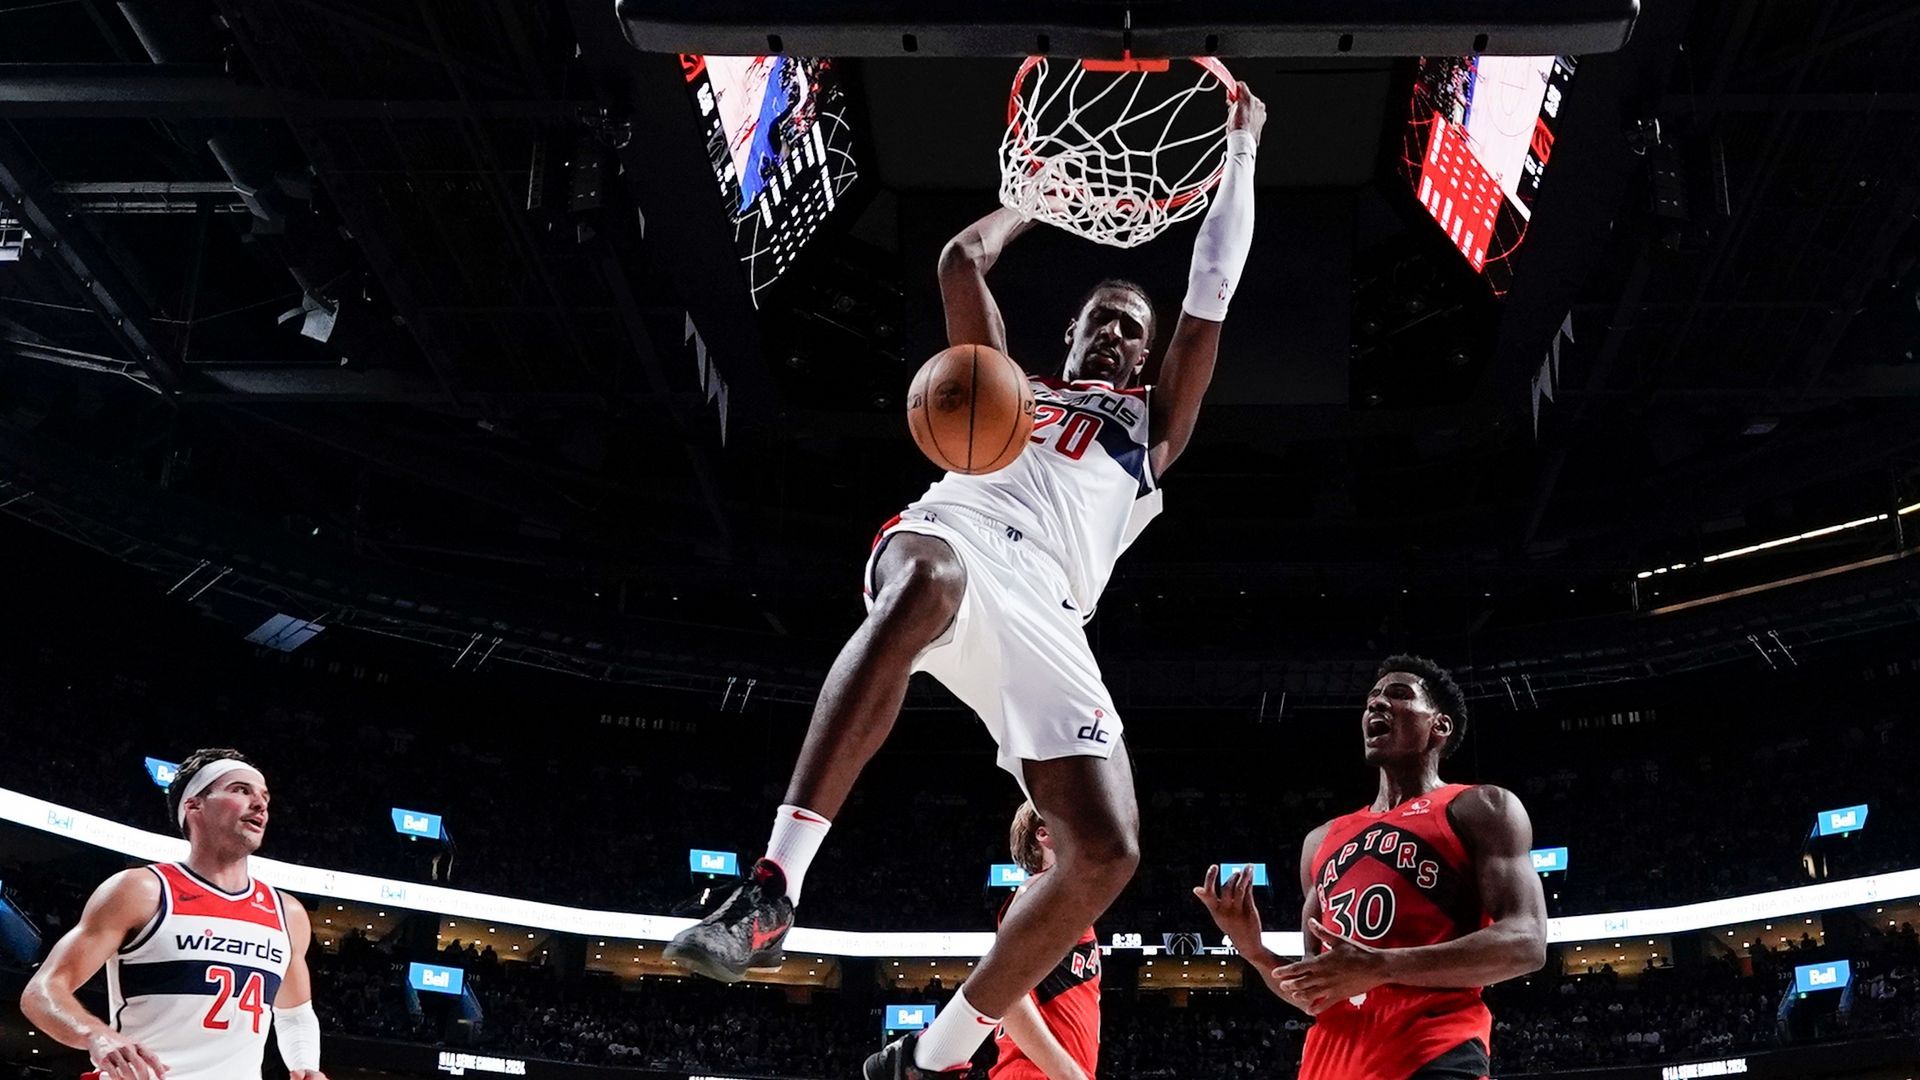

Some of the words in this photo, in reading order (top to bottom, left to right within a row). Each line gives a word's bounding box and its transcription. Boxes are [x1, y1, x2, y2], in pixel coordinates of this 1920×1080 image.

[1030, 404, 1104, 461] 20
[1077, 709, 1109, 744] dc
[157, 765, 175, 783] Be
[403, 814, 429, 832] Bell
[1830, 810, 1857, 829] Bell
[701, 854, 725, 869] Bell
[1532, 852, 1557, 868] Bell
[1002, 868, 1025, 881] Bell
[1329, 884, 1396, 940] 30
[176, 929, 284, 964] wizards
[422, 968, 450, 987] Bell
[1809, 966, 1837, 985] Bell
[203, 965, 265, 1034] 24
[898, 1009, 924, 1025] Bell
